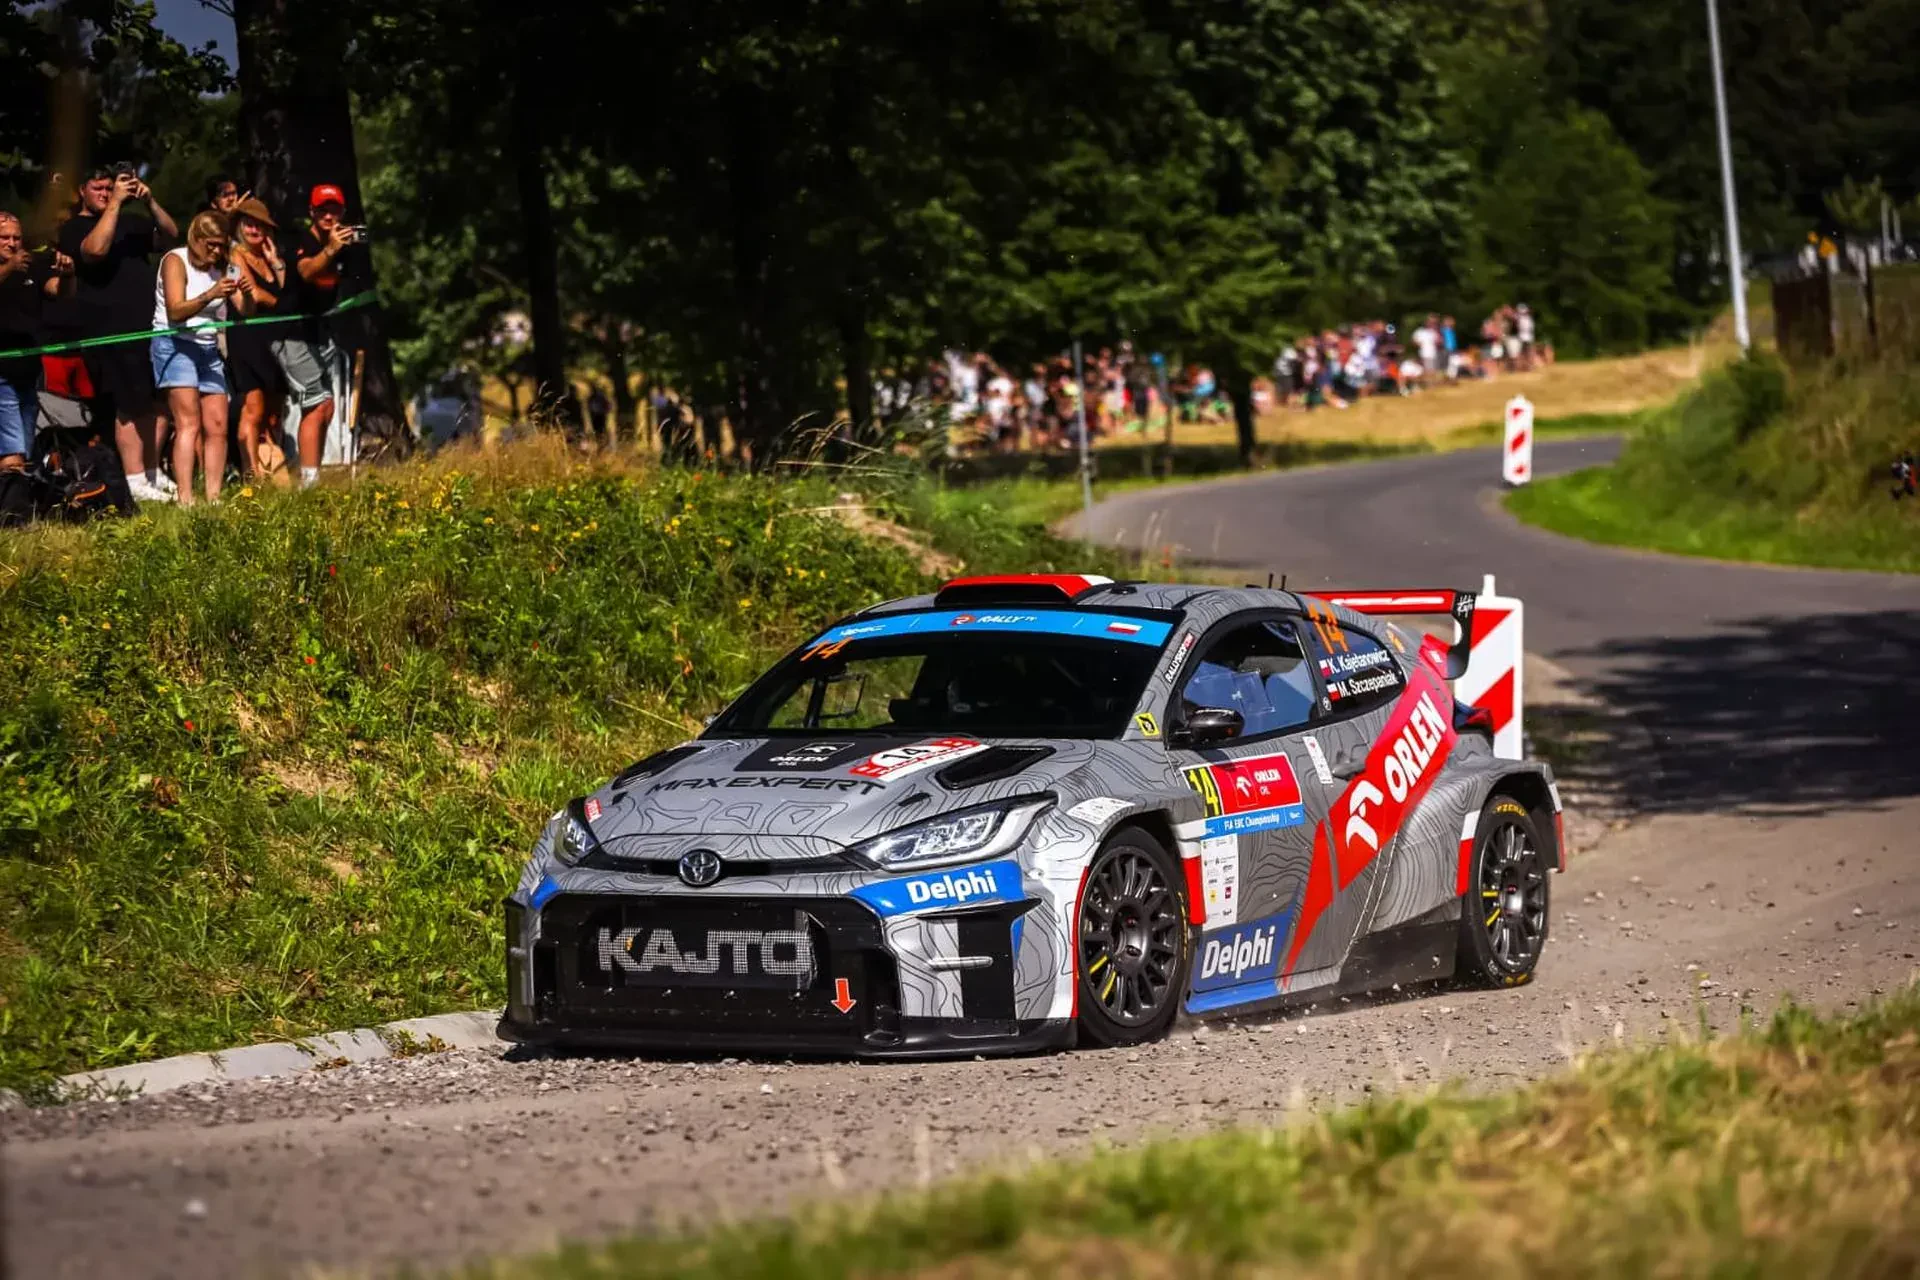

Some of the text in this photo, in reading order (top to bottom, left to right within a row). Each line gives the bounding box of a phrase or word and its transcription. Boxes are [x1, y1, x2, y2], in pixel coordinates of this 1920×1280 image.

[977, 615, 1025, 623] RALLY
[1308, 601, 1348, 654] 14
[801, 636, 853, 661] 14
[1328, 649, 1391, 674] K. Kajetanowicz
[1338, 670, 1399, 697] M. Szczepaniak
[880, 748, 931, 760] 14
[1384, 690, 1447, 803] ORLEN
[645, 776, 887, 796] MAX EXPERT
[1254, 769, 1281, 783] ORLEN
[1188, 766, 1220, 817] 14
[905, 870, 997, 904] Delphi
[598, 926, 812, 976] KAJTO
[1200, 925, 1276, 980] Delphi
